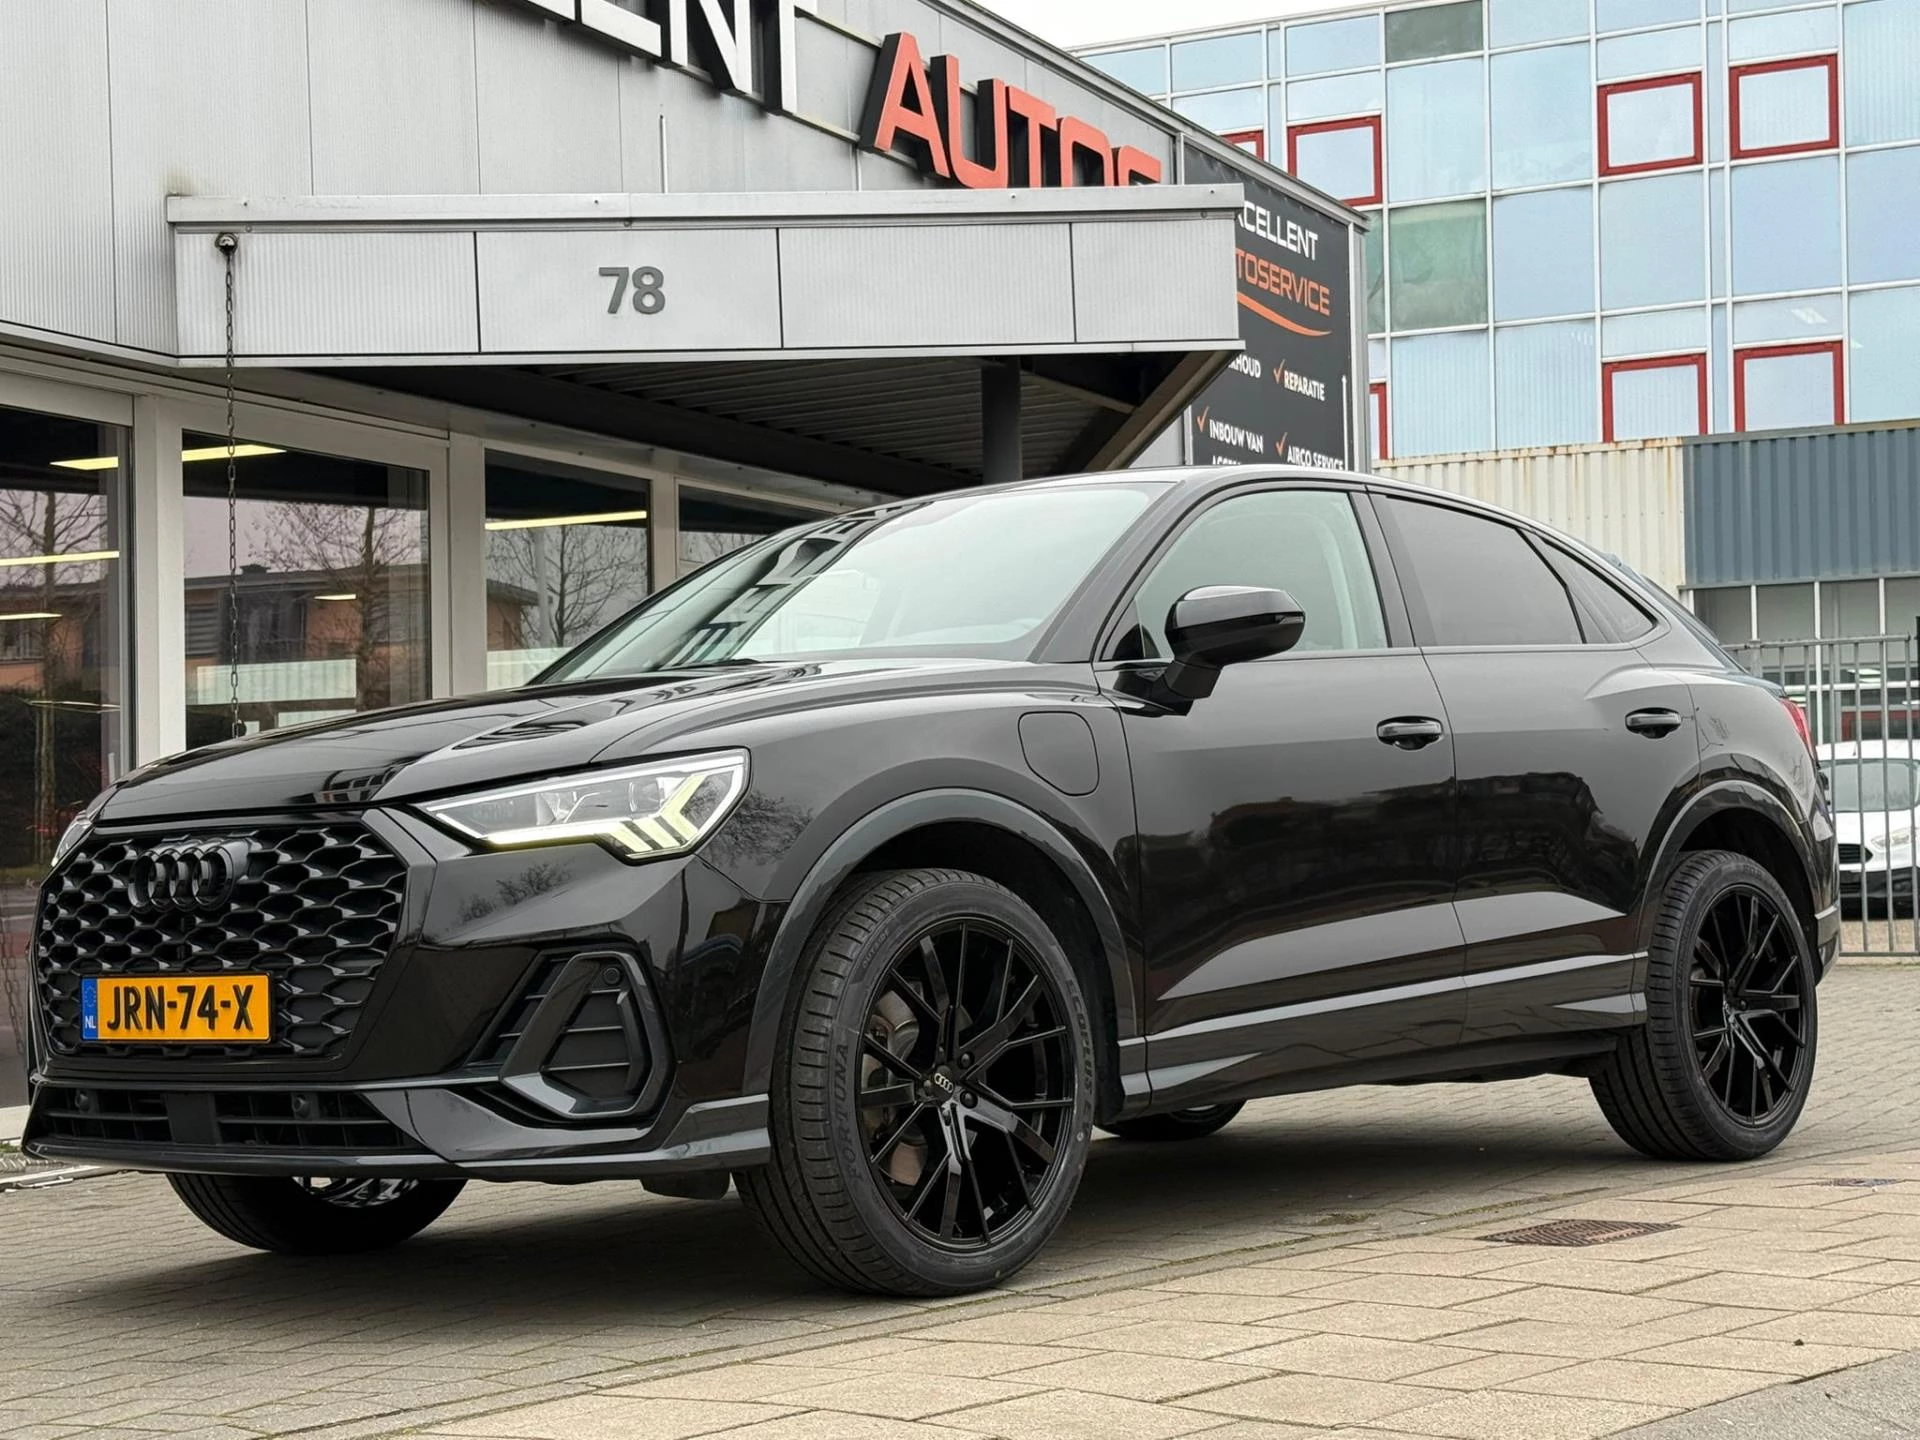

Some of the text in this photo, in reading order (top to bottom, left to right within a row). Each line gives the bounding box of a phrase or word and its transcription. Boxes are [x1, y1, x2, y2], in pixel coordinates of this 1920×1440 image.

[599, 266, 665, 314] 78
[1284, 370, 1325, 401] REPARATIE
[1209, 419, 1264, 454] INBOUW VAN
[1287, 445, 1311, 467] AIRCO
[84, 1015, 97, 1029] NL
[107, 985, 254, 1030] JRN-74-X
[834, 1043, 864, 1183] FORTUNA
